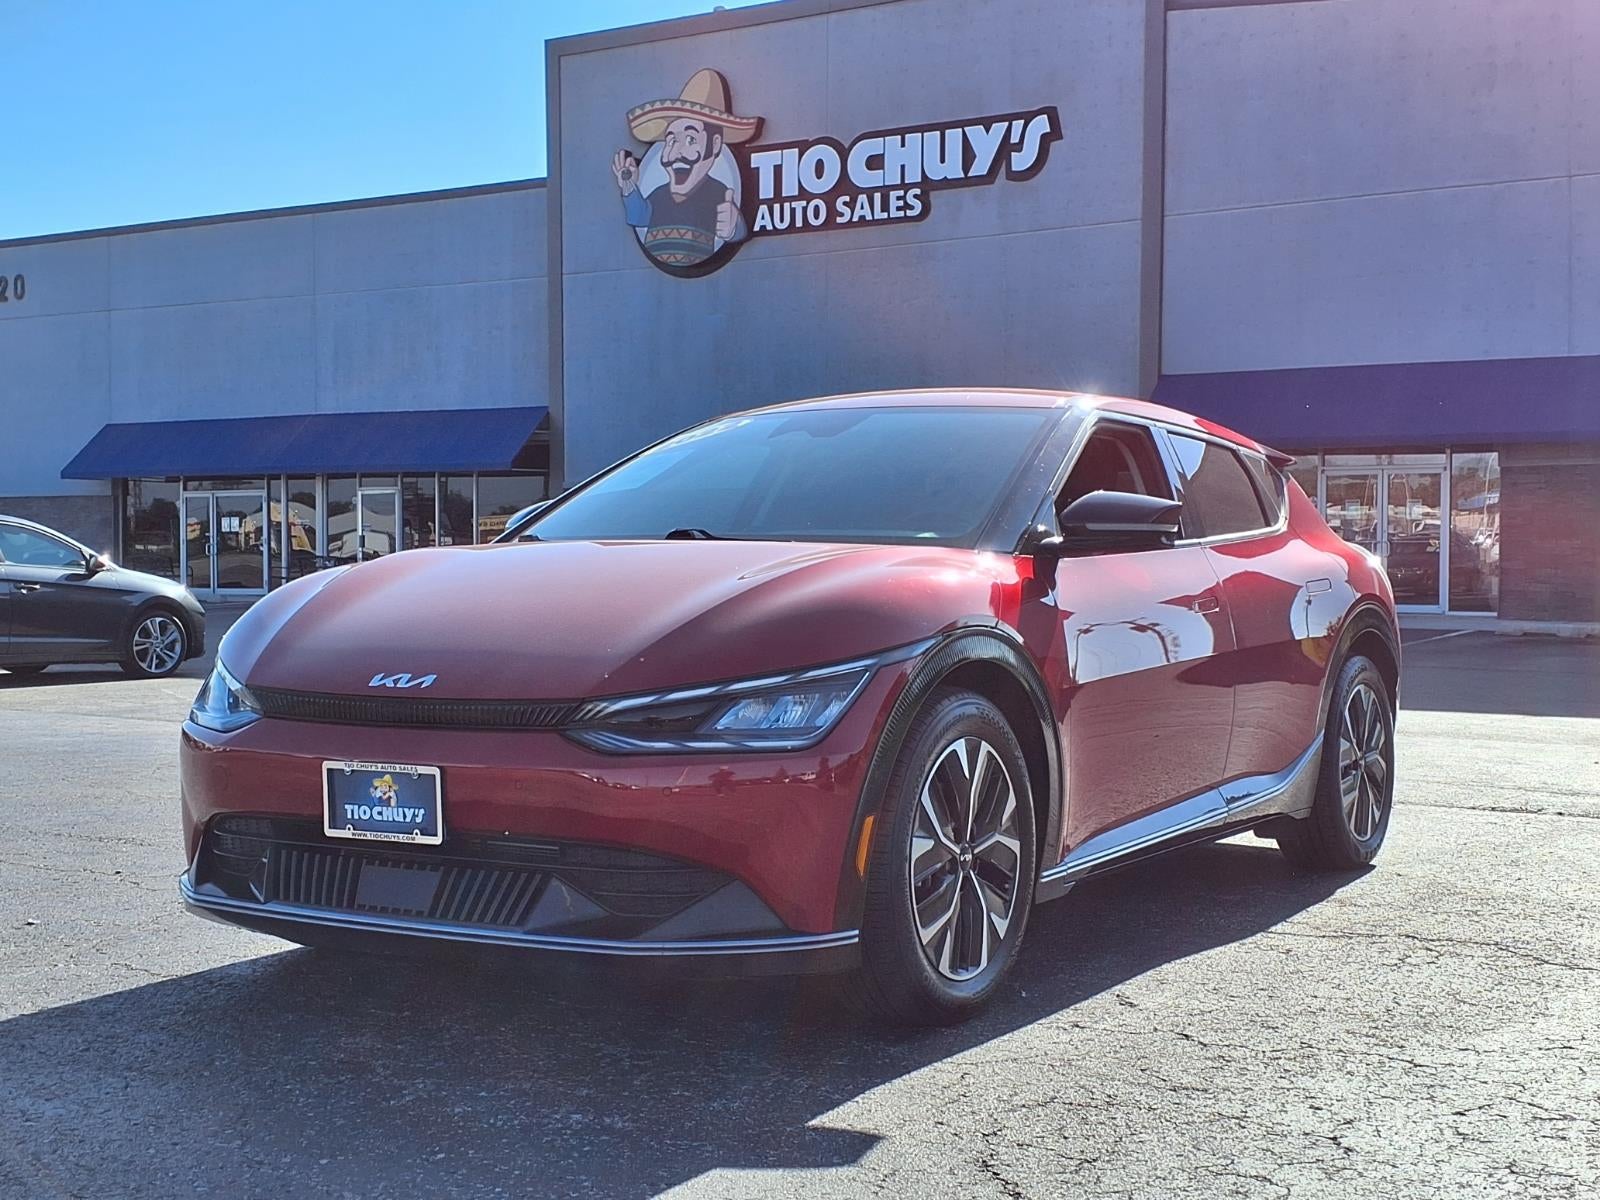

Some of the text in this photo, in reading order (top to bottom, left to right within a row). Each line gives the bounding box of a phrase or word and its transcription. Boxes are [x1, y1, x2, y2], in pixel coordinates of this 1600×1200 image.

[750, 114, 1051, 199] TIO CHUY'S
[753, 188, 922, 232] AUTO SALES
[345, 804, 425, 823] TIO CHUY'S
[351, 832, 416, 841] WWW.TIOCHUYS.COM
